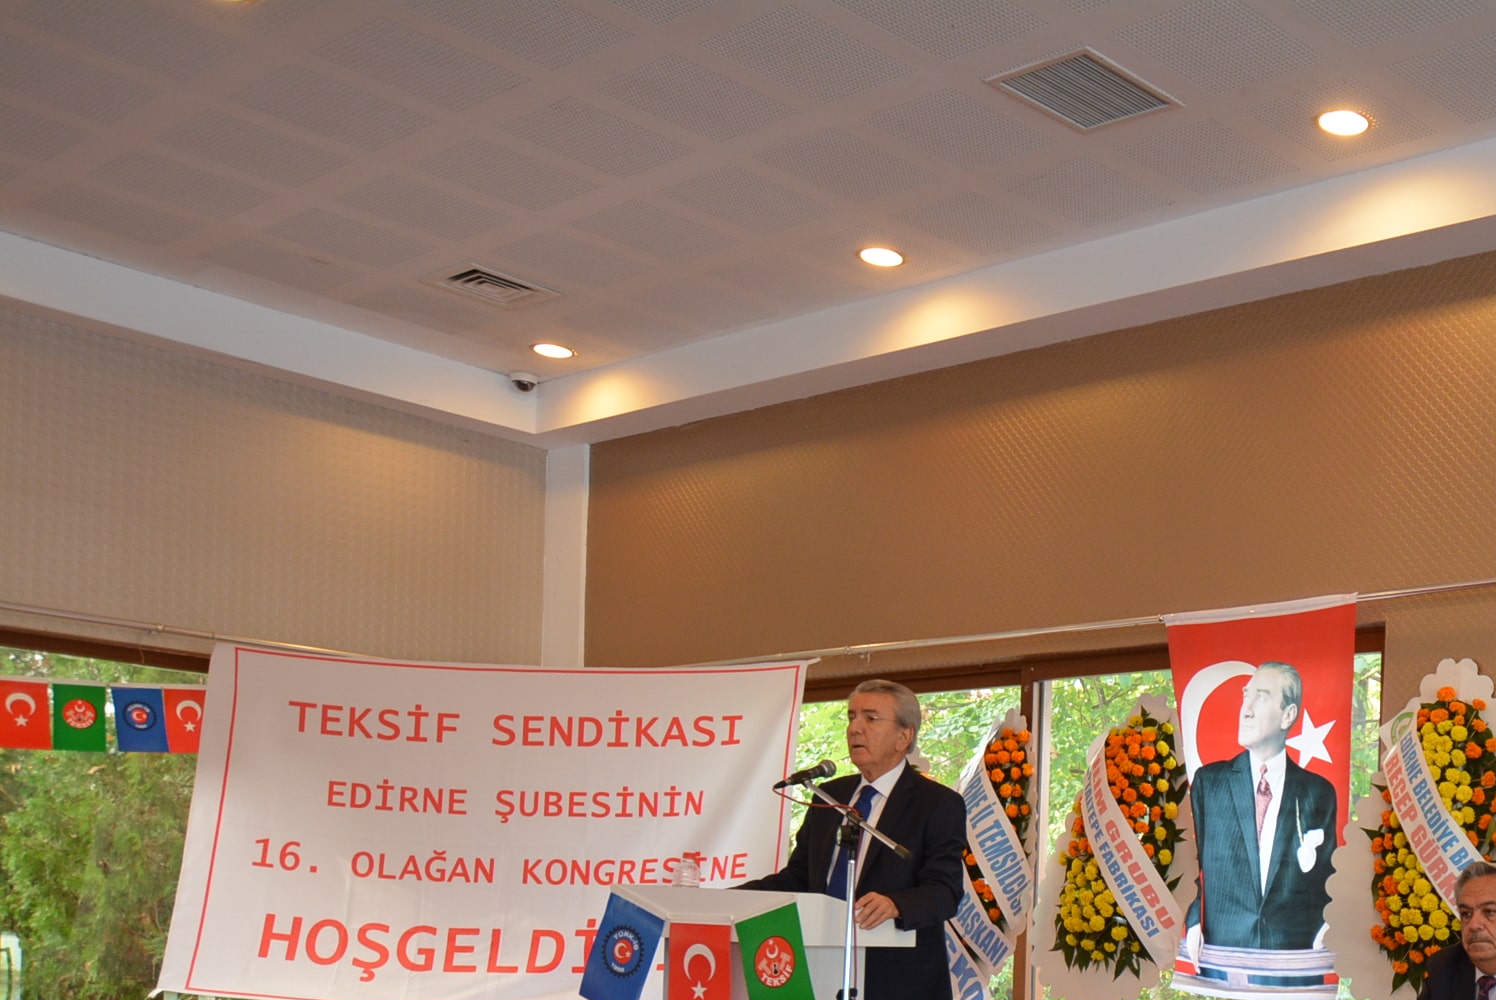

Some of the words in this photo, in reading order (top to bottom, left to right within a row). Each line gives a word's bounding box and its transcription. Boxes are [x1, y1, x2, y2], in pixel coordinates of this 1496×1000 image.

[288, 700, 461, 744] TEKSİF
[491, 709, 744, 748] SENDİKASI
[327, 778, 468, 816] EDİRNE
[494, 785, 705, 824] ŞUBESİNİN
[970, 802, 997, 830] İL
[1385, 752, 1419, 823] RECEP
[1410, 824, 1458, 906] GÜRK
[1412, 778, 1460, 853] BELEDİYE
[251, 837, 319, 874] 16.
[350, 849, 496, 884] OLAĞAN
[1098, 841, 1160, 939] FABRİKASI
[1105, 820, 1176, 930] GRUBU
[257, 913, 664, 983] HOŞGELDİ
